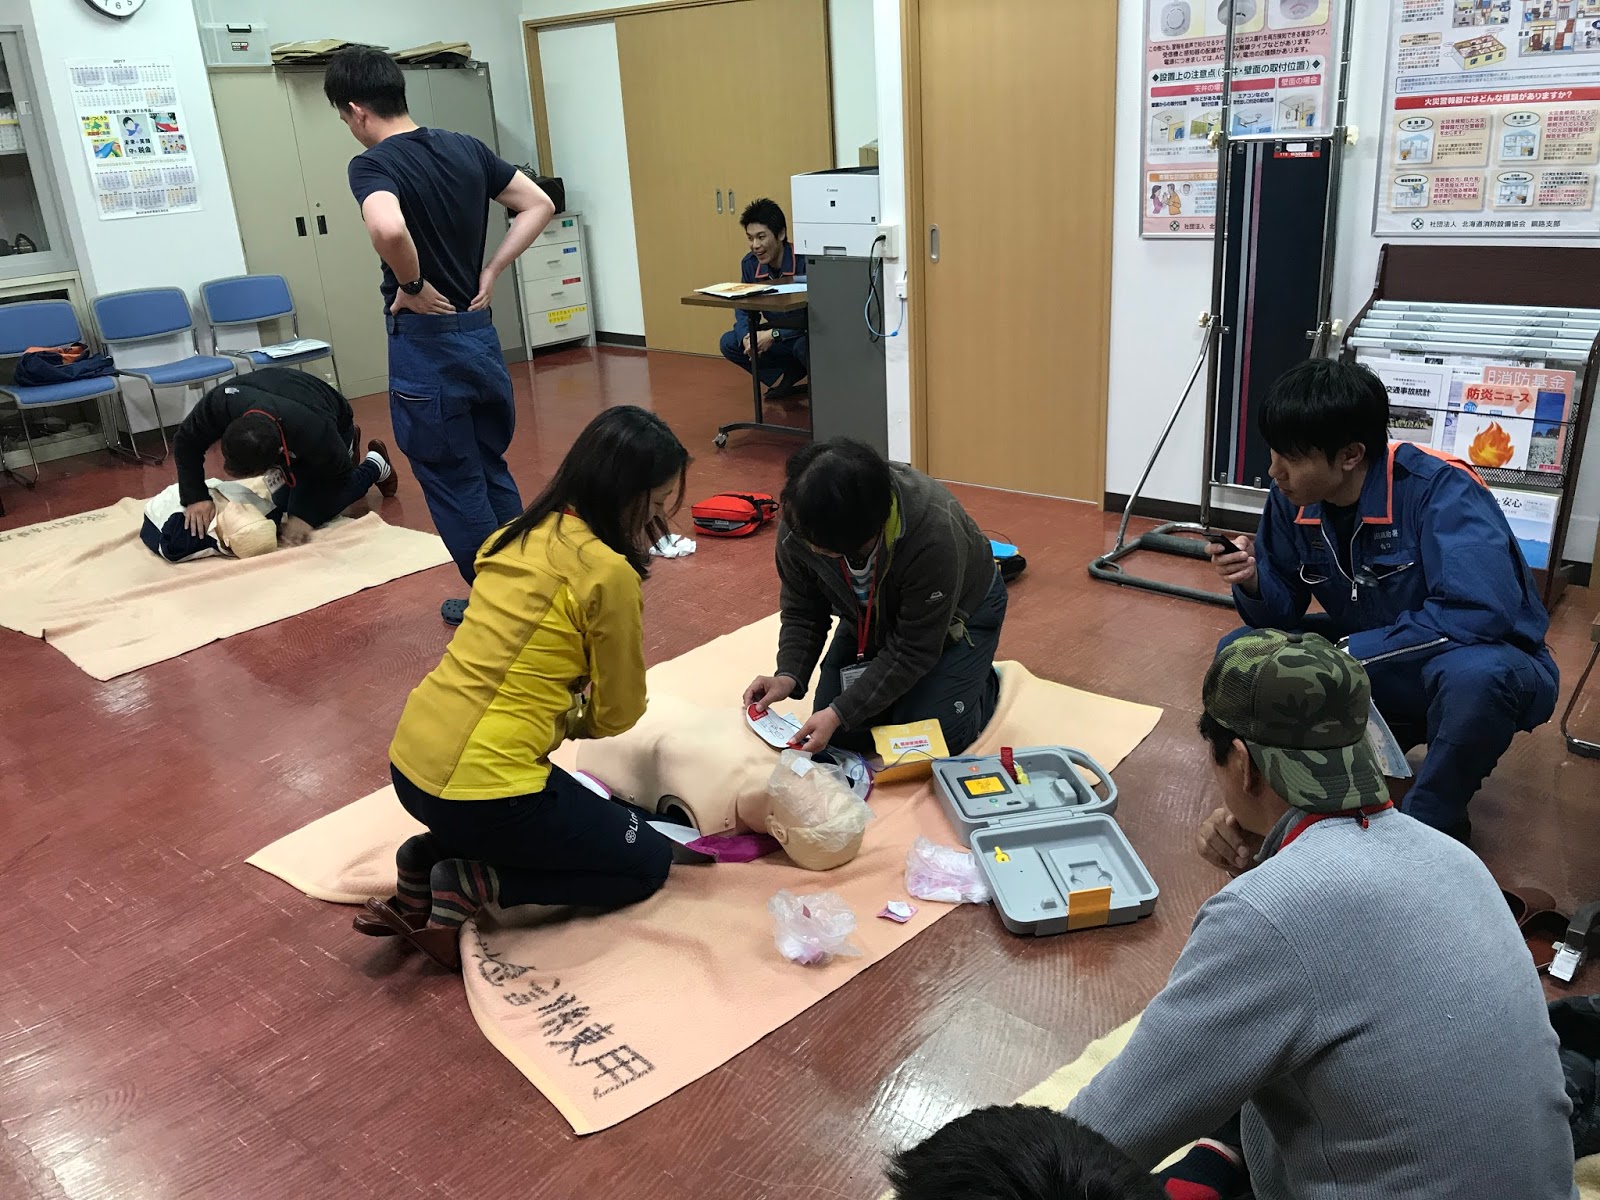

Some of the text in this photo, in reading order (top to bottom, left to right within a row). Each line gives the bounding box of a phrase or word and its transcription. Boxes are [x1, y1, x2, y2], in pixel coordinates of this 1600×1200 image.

[115, 1, 122, 10] 6
[1430, 220, 1457, 228] 社団法人
[1461, 220, 1527, 228] 北海道消防設備協会
[1497, 370, 1566, 390] 消防基金
[1466, 387, 1530, 403] 防炎ニュース
